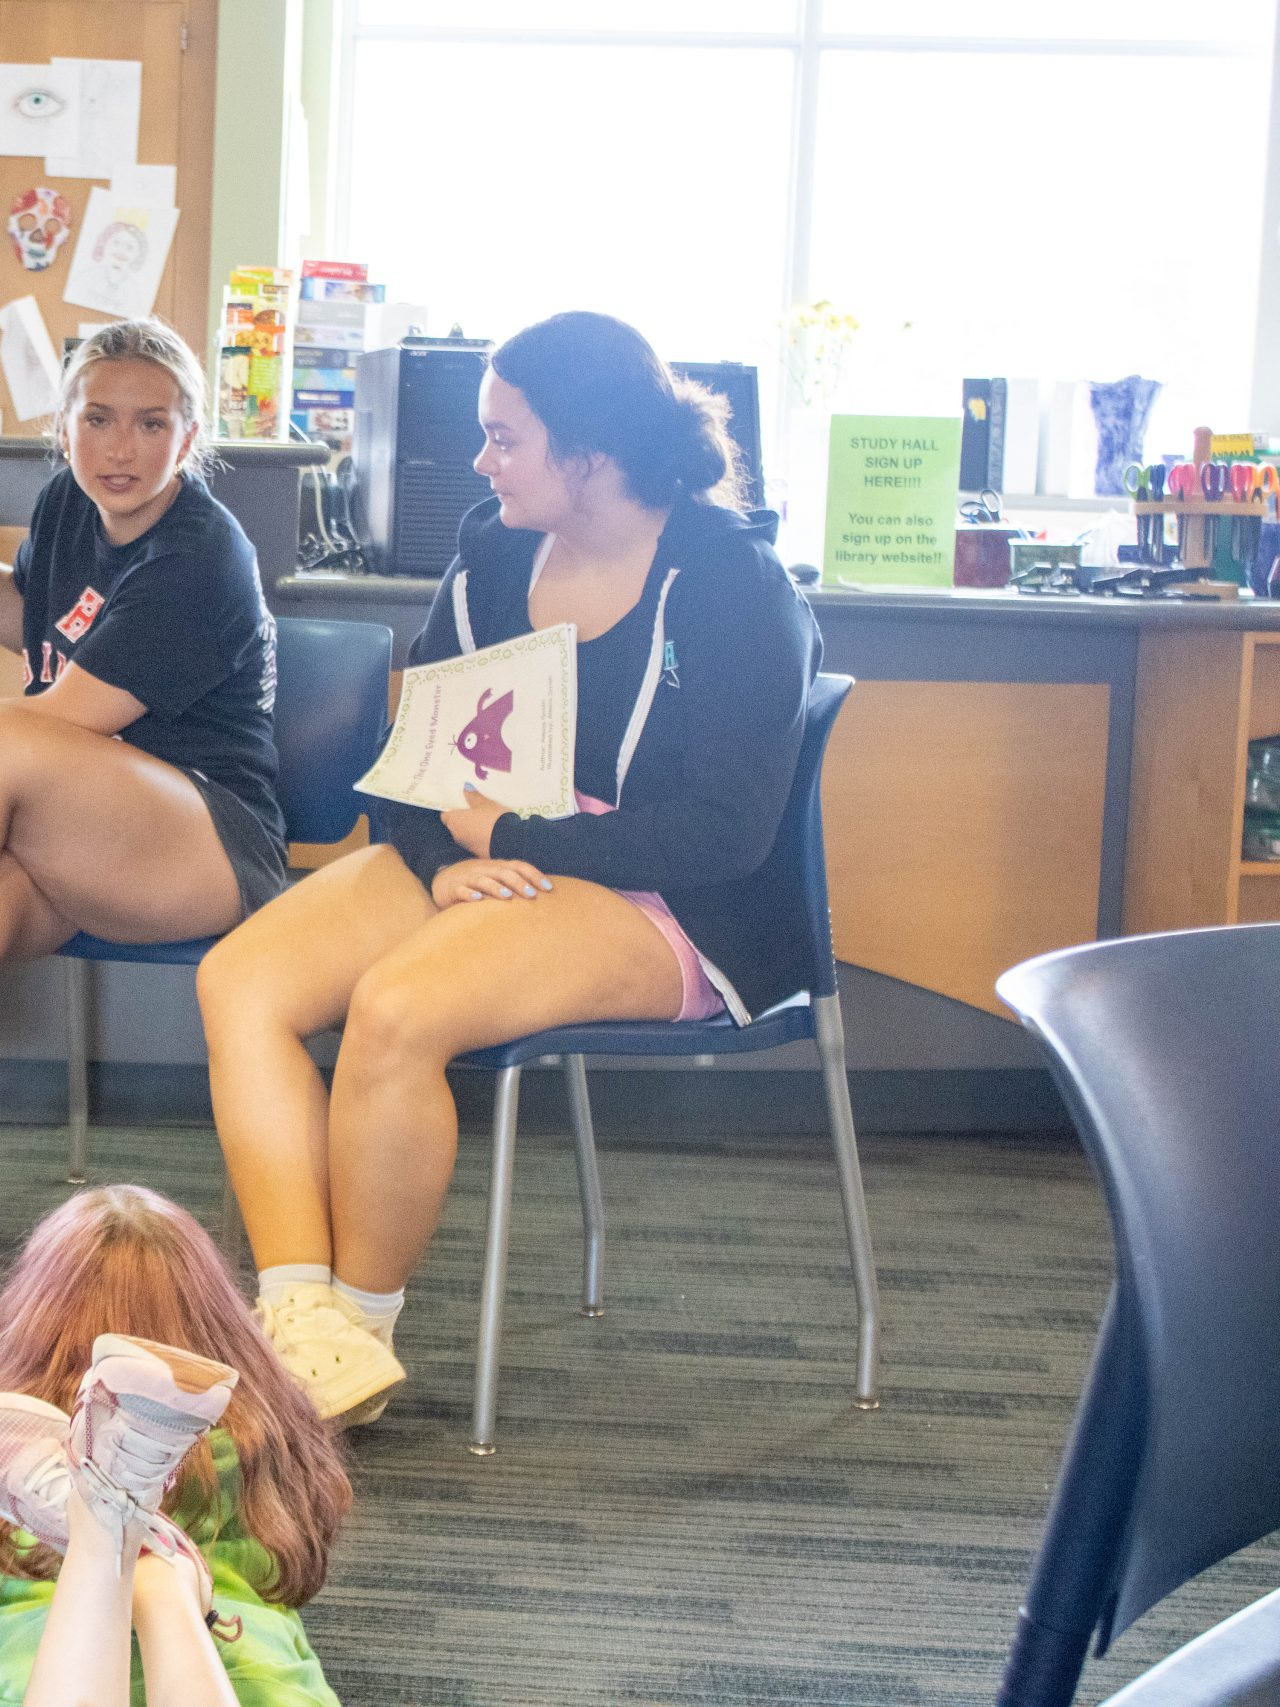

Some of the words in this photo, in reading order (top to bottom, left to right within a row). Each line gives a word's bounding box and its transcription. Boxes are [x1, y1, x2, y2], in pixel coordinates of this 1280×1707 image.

[850, 437, 897, 450] STUDY
[902, 439, 939, 451] HALL
[865, 457, 898, 469] SIGN
[903, 458, 923, 469] UP
[848, 512, 873, 525] You
[877, 516, 901, 525] can
[905, 516, 934, 526] also
[842, 534, 870, 546] sign
[875, 535, 892, 546] up
[896, 536, 912, 545] on
[916, 534, 937, 545] the
[835, 551, 877, 565] library
[881, 553, 942, 564] website!!
[429, 684, 442, 727] Monster
[424, 729, 437, 751] Eyed
[420, 751, 433, 768] One
